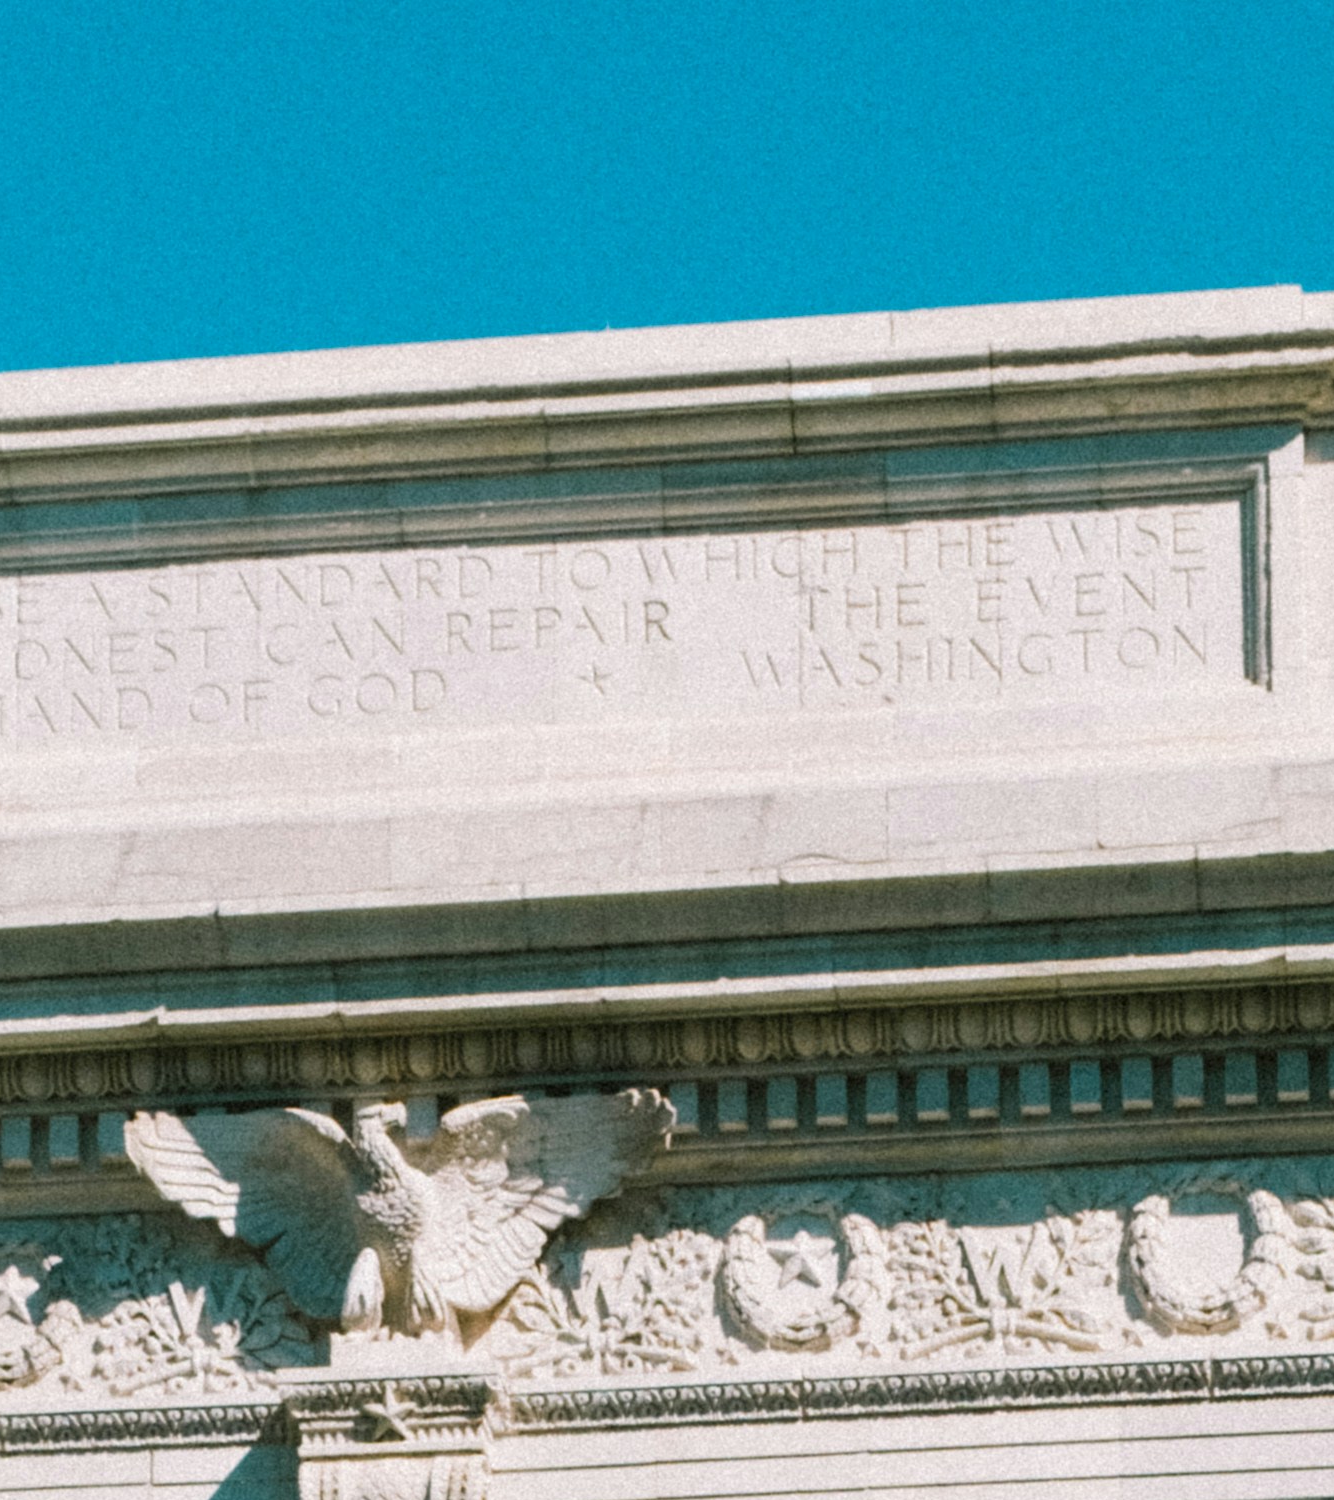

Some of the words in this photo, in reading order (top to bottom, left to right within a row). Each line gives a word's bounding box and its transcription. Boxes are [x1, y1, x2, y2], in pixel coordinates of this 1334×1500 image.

[146, 553, 493, 617] STANDARD
[522, 547, 611, 593] TO
[635, 527, 858, 584] WHICH
[889, 520, 1016, 571] THE
[1047, 508, 1204, 562] WISE
[265, 614, 406, 665] CAN
[447, 598, 672, 656] REPAIR
[797, 581, 926, 632] THE
[976, 564, 1207, 623] EVENT
[188, 678, 271, 726] OF
[307, 668, 447, 717] GOD
[739, 621, 1208, 690] WASHINGTON
